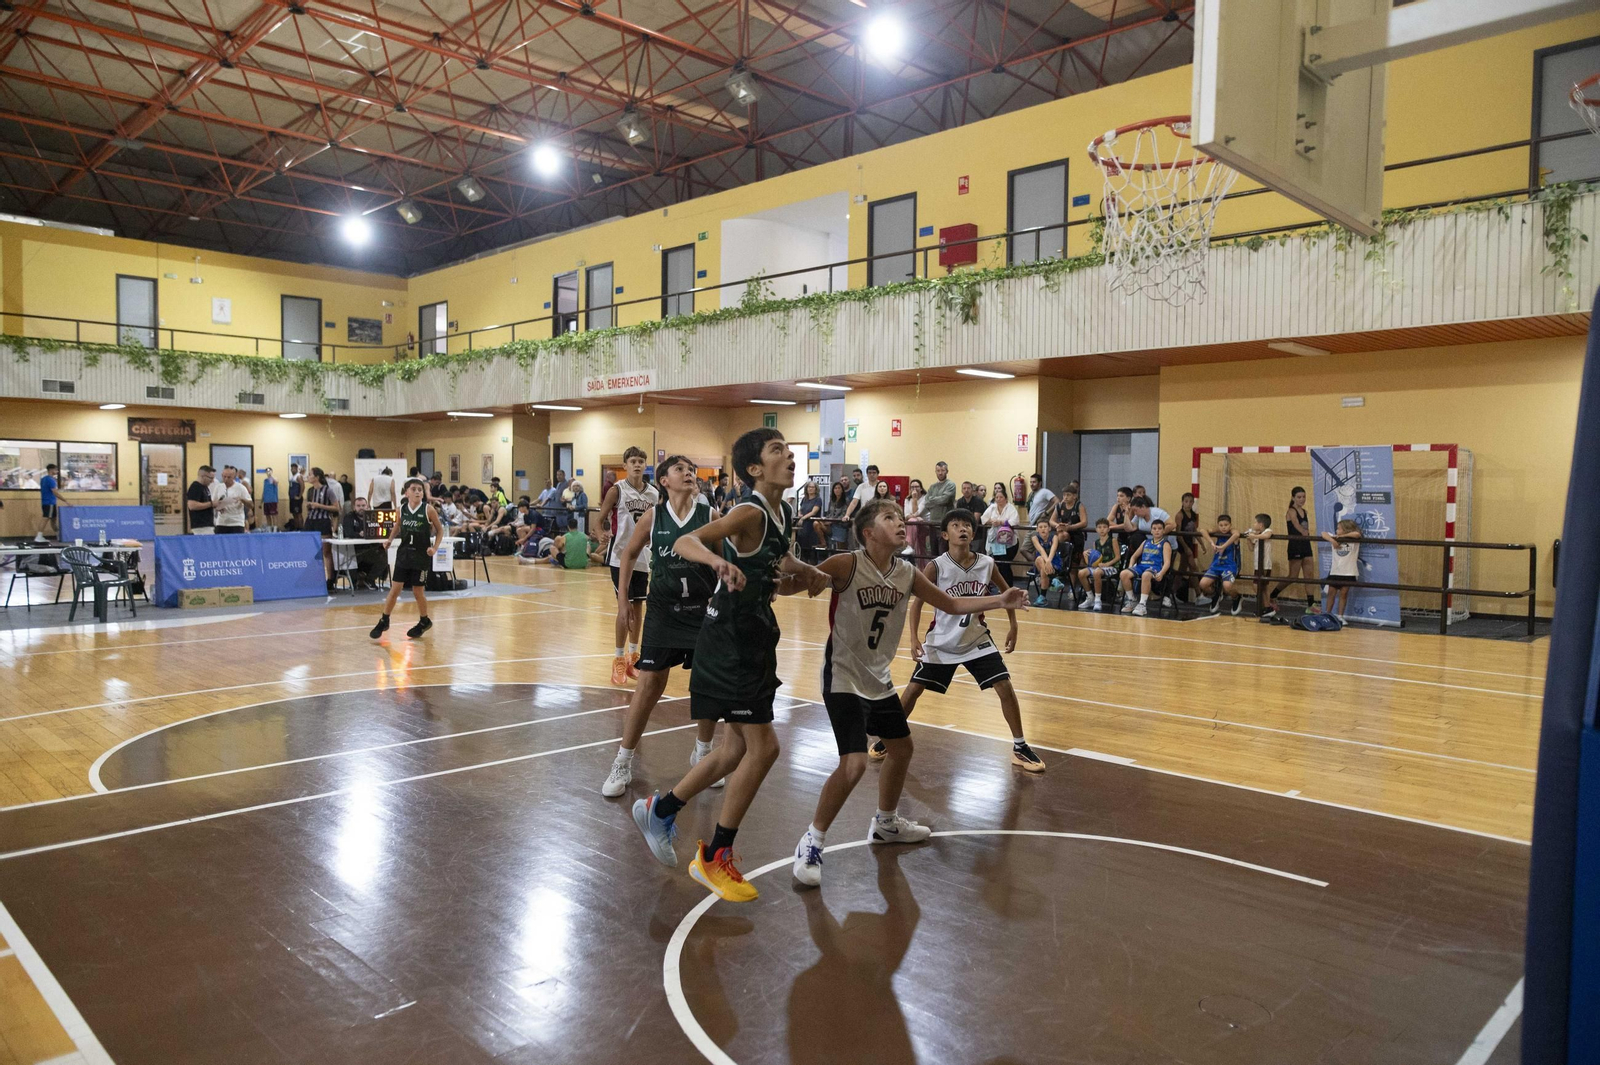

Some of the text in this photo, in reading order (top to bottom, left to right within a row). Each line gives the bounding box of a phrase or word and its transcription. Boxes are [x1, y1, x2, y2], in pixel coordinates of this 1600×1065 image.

[377, 511, 397, 523] 3:4
[200, 558, 308, 570] DEPUTACIÓN DEPORTES
[200, 568, 244, 578] OURENSE
[680, 577, 690, 598] 1
[867, 609, 890, 650] 5
